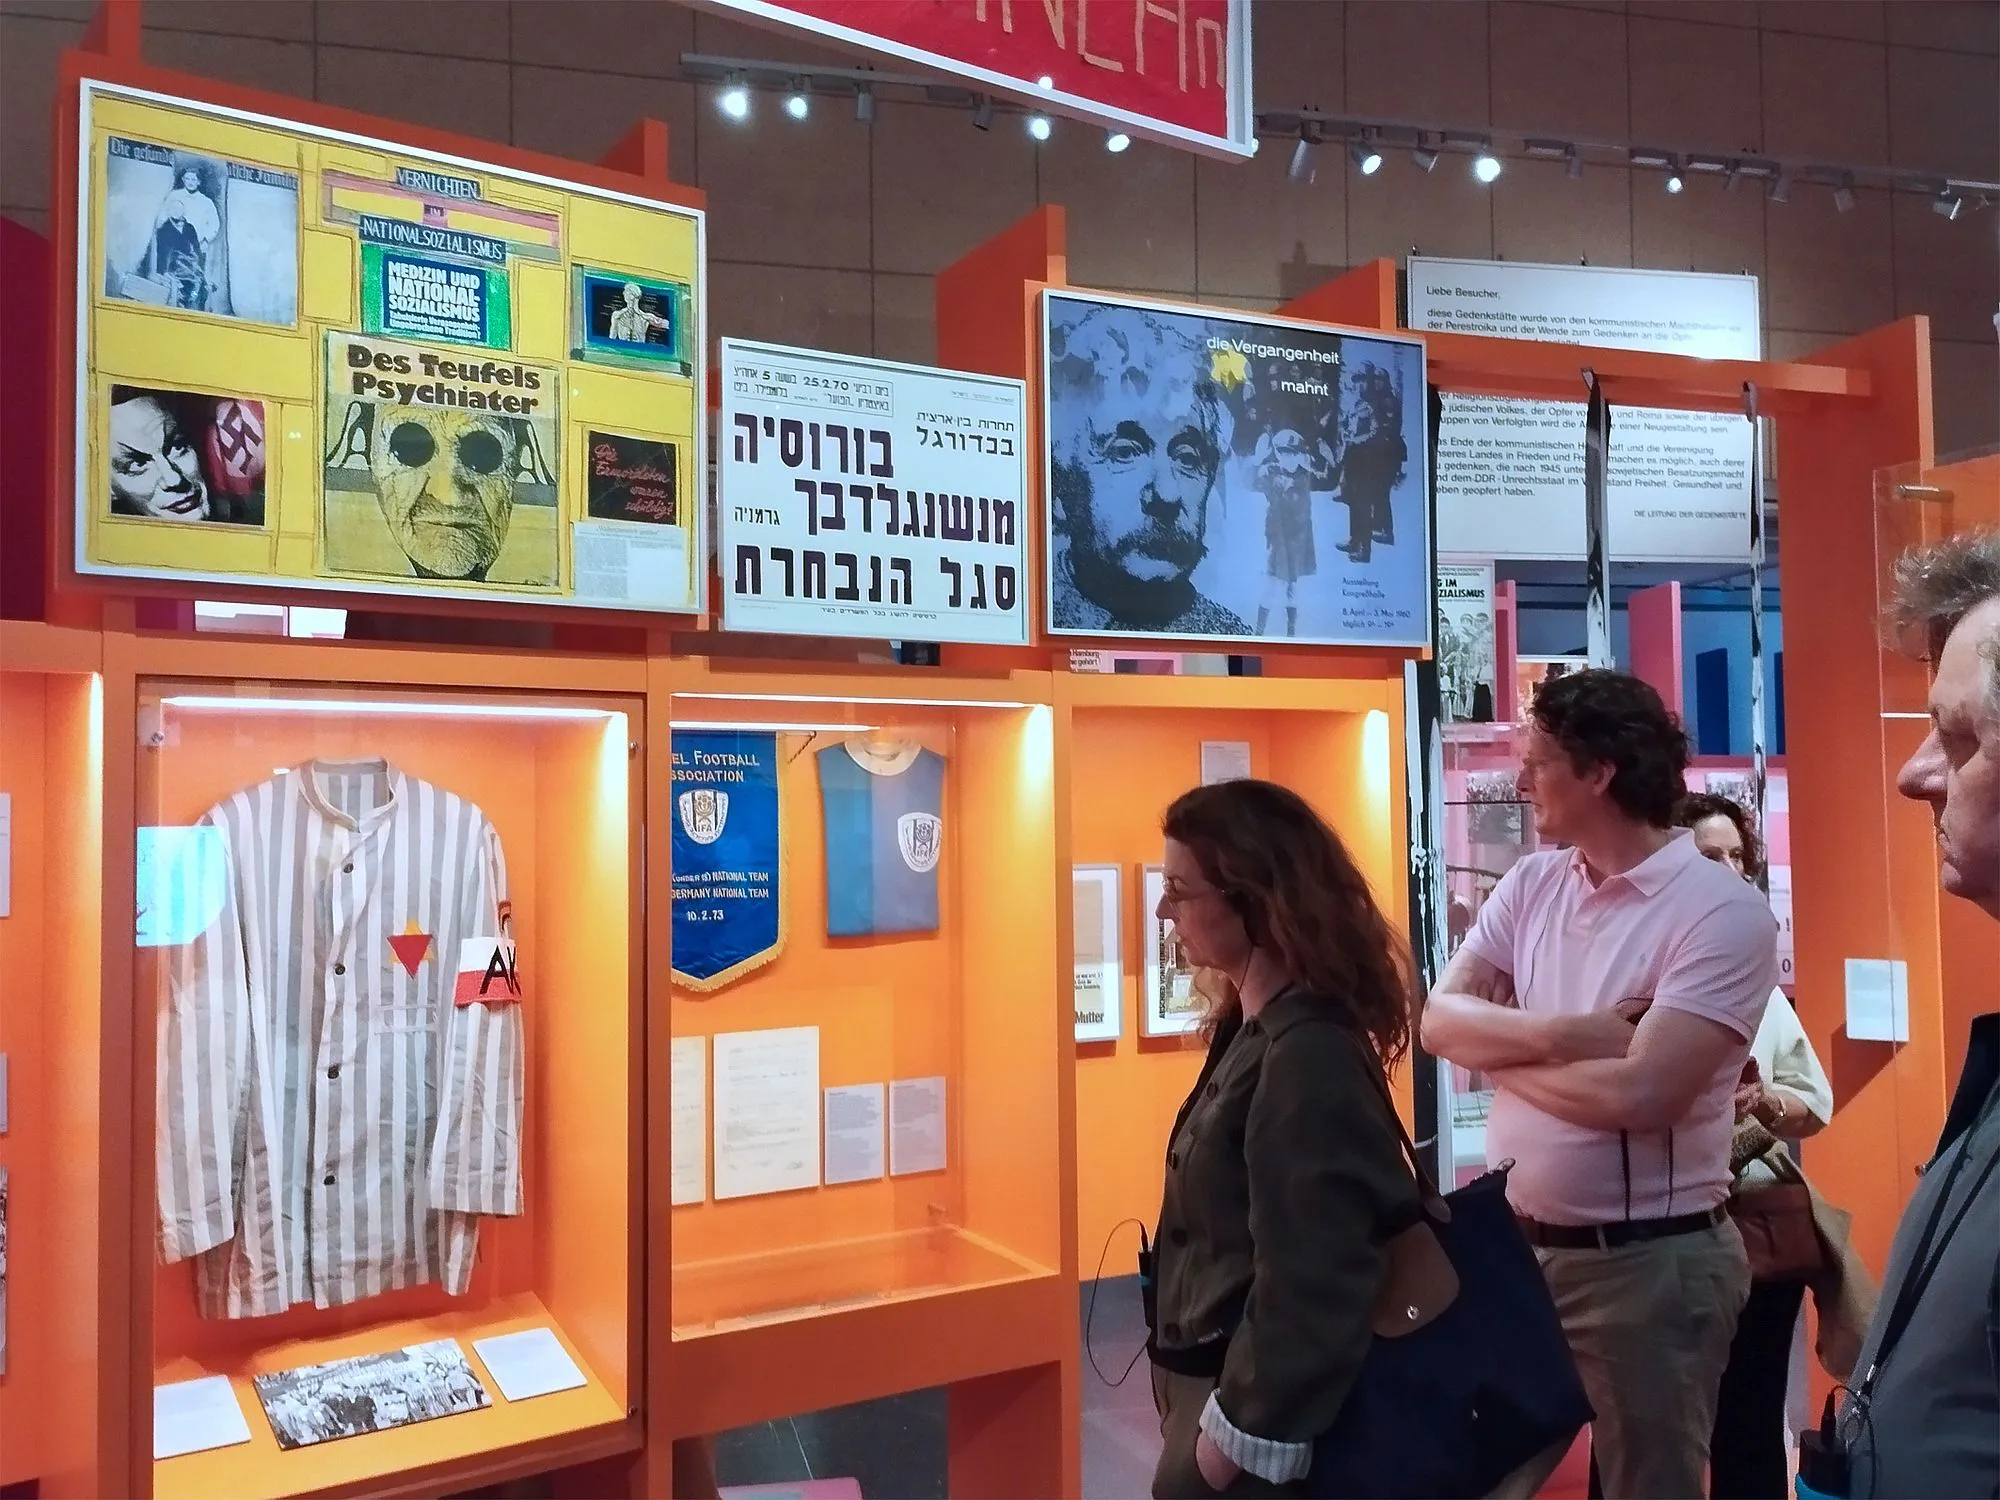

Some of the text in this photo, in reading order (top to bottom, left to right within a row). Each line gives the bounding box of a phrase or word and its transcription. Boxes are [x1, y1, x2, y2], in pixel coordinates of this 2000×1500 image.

[396, 167, 478, 199] VERNICHTEN
[361, 216, 503, 260] NATIONALSOZIALISMUS
[388, 260, 481, 290] MEDIZIN UND
[388, 275, 481, 308] NATIONAL-
[1426, 285, 1501, 300] Liebe Besucher,
[388, 294, 481, 323] SOZIALISMUS
[1427, 308, 1452, 318] diese
[1455, 309, 1517, 322] Gedenkstätte
[1520, 313, 1548, 323] wurde
[1550, 315, 1566, 324] von
[1569, 315, 1586, 325] den
[1588, 316, 1667, 329] kommunistischen
[1427, 320, 1443, 330] der
[1446, 321, 1497, 333] Perestroika
[1500, 323, 1518, 334] und
[1520, 325, 1536, 334] der
[1537, 325, 1569, 336] Wende
[1572, 328, 1591, 337] zum
[1593, 329, 1639, 340] Gedenken
[1206, 336, 1340, 365] die Vergangenheit
[348, 344, 541, 390] Des Teufels
[762, 370, 771, 381] 5
[803, 376, 849, 391] 25.2.70
[1281, 379, 1330, 397] mahnt
[353, 372, 539, 415] Psychiater
[1449, 403, 1493, 414] jüdischen
[1495, 404, 1528, 416] Volkes,
[1531, 406, 1546, 416] der
[1548, 407, 1573, 419] Opfer
[1616, 409, 1635, 420] und
[1637, 410, 1662, 421] Roma
[1665, 412, 1690, 422] sowie
[1693, 412, 1709, 422] der
[1710, 413, 1743, 425] übrigen
[978, 419, 1014, 432] תחרות
[1441, 415, 1470, 426] uppen
[1473, 416, 1489, 426] von
[1492, 416, 1538, 429] Verfolgten
[1540, 418, 1560, 428] wird
[1562, 419, 1576, 429] die
[1619, 421, 1641, 431] einer
[1644, 422, 1708, 434] Neugestaltung
[734, 412, 894, 478] בורוסיה
[916, 425, 1014, 457] בכדורגל
[1450, 436, 1476, 447] Ende
[1477, 437, 1493, 448] der
[1495, 437, 1575, 449] kommunistischen
[1627, 443, 1645, 453] und
[1646, 444, 1661, 453] die
[1663, 444, 1714, 455] Vereinigung
[1438, 450, 1467, 460] nseres
[1469, 449, 1503, 461] Landes
[1506, 450, 1515, 461] in
[1517, 450, 1551, 461] Frieden
[1553, 452, 1570, 462] und
[1608, 454, 1644, 464] machen
[1646, 456, 1658, 465] es
[1699, 457, 1721, 467] auch
[1496, 463, 1510, 472] die
[1513, 464, 1536, 473] nach
[1540, 464, 1562, 473] 1945
[1563, 466, 1586, 475] unte
[1607, 467, 1665, 478] sowjetischen
[1667, 467, 1746, 479] Besatzungsmacht
[1451, 473, 1472, 483] dem
[1474, 474, 1496, 484] DDR
[1567, 477, 1579, 485] im
[1672, 479, 1723, 490] Gesundheit
[1726, 479, 1742, 490] und
[1462, 486, 1501, 497] geopfert
[1503, 487, 1536, 497] haben.
[734, 478, 1015, 546] מנשנגלדבך גרמניה
[1634, 509, 1646, 518] DIE
[1647, 510, 1678, 519] LEITUNG
[1679, 510, 1694, 519] DER
[735, 544, 1015, 611] סגל הנבחרת
[1445, 578, 1458, 588] IM
[1438, 588, 1485, 598] ZIALISMUS
[671, 752, 690, 765] EL
[671, 770, 745, 783] SSOCIATION
[697, 823, 713, 833] IFA
[712, 870, 747, 882] NATIONAL
[747, 871, 769, 882] TEAM
[713, 887, 748, 899] NATIONAL
[748, 888, 769, 899] TEAM
[686, 909, 725, 921] 10.2.73
[1074, 1010, 1104, 1024] Mutter
